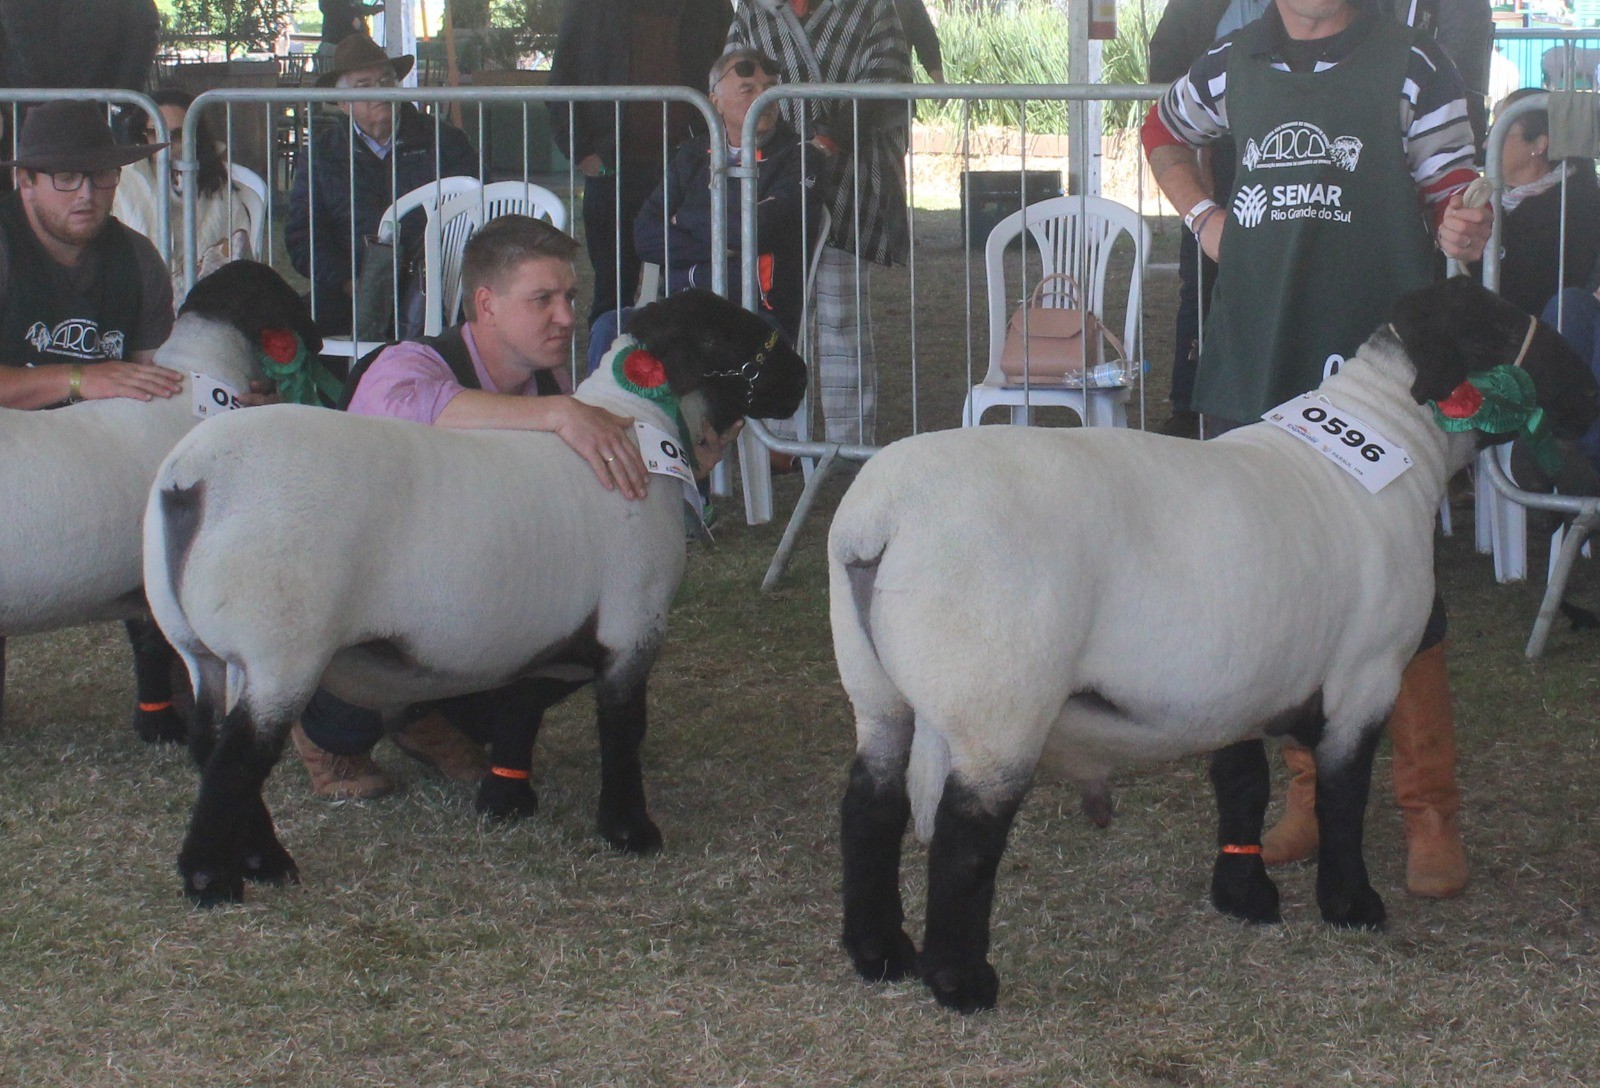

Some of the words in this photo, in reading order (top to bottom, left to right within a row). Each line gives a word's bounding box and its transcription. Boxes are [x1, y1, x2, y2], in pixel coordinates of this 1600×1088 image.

[1272, 183, 1342, 207] SENAR
[1271, 209, 1286, 221] Rio
[1288, 206, 1316, 220] Grande
[1318, 208, 1332, 220] do
[1334, 210, 1352, 223] Sul
[1302, 407, 1386, 463] 0596
